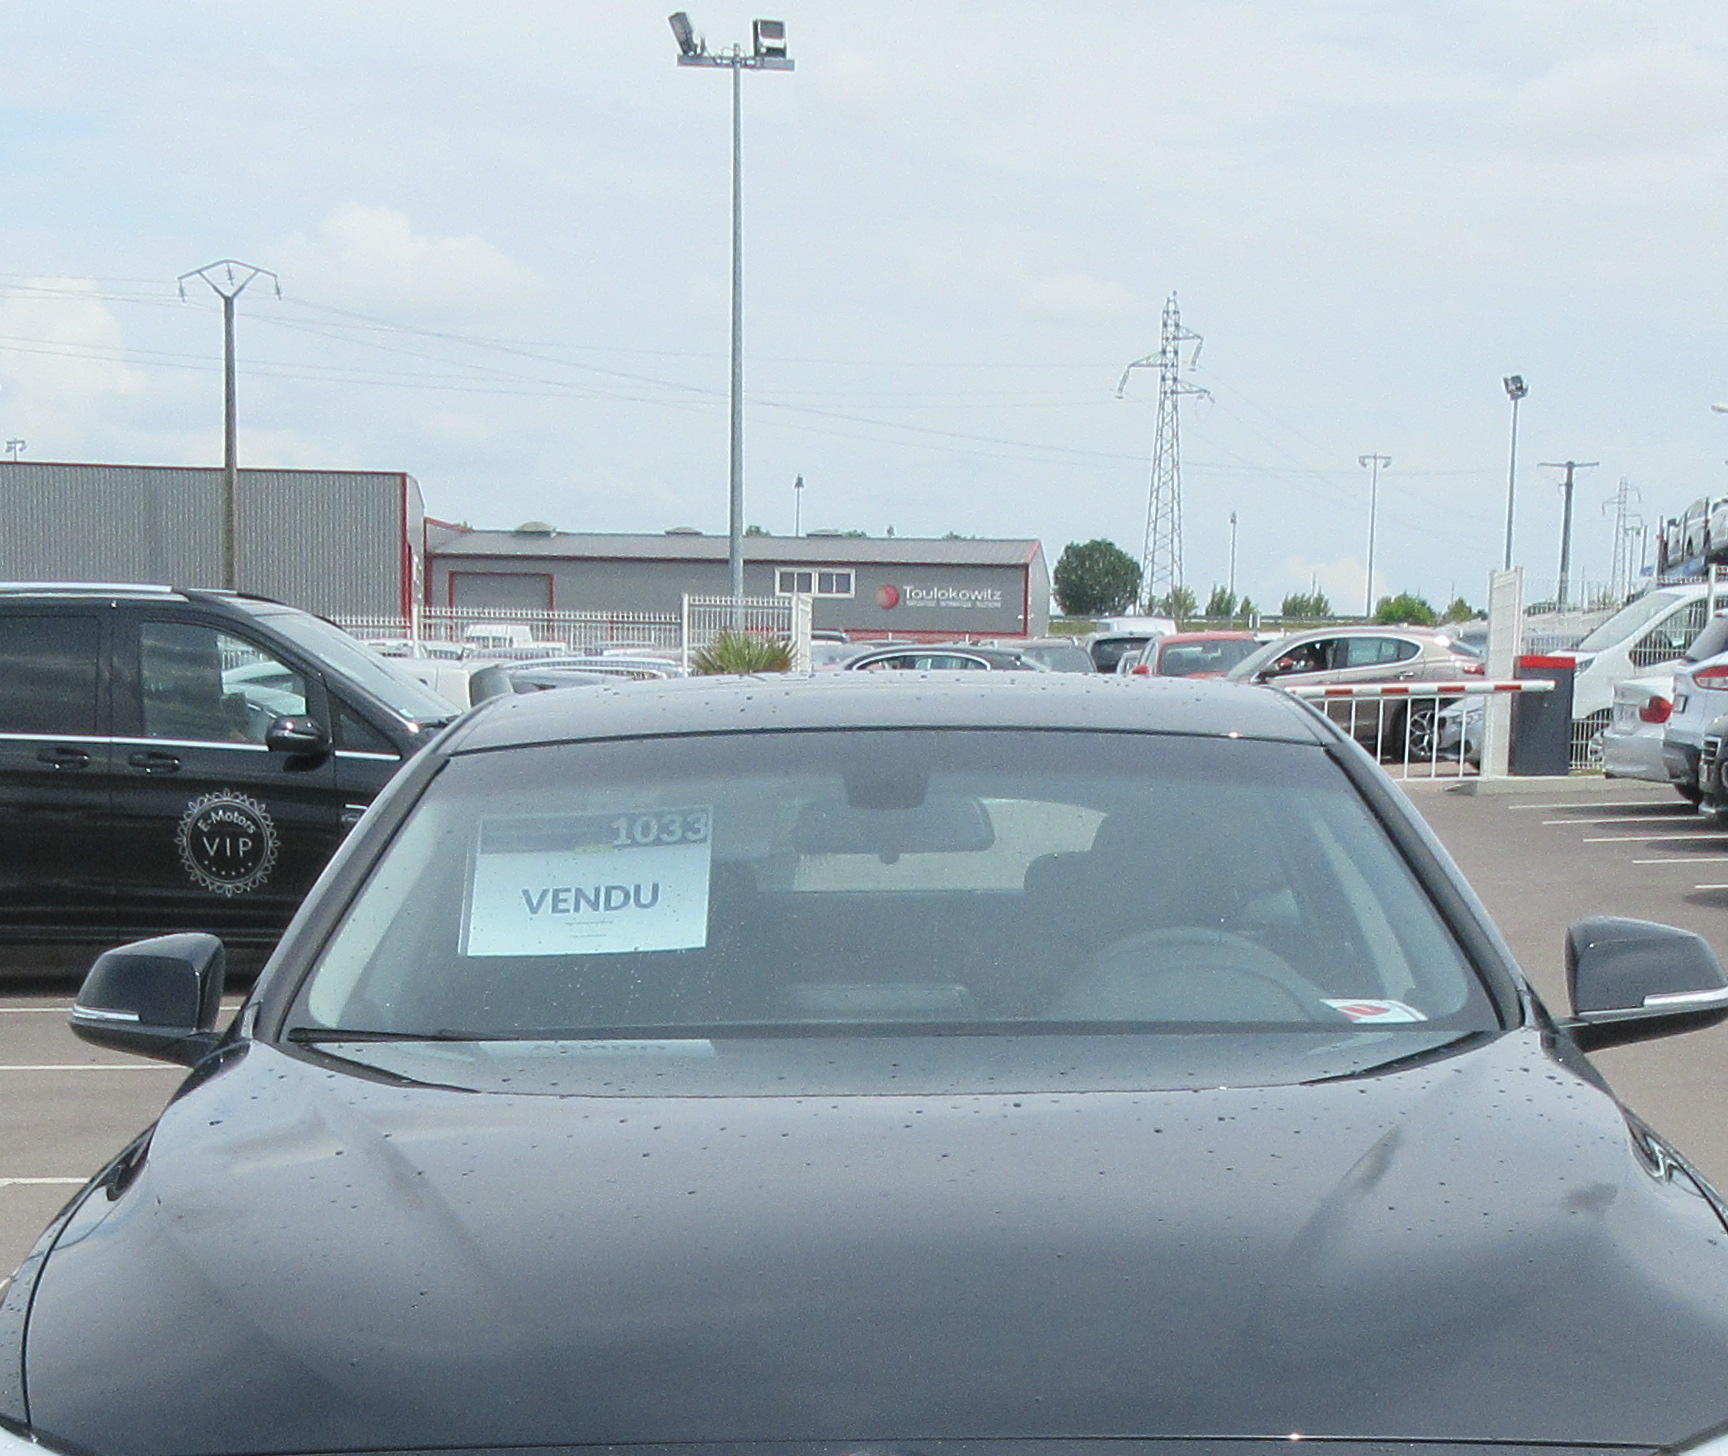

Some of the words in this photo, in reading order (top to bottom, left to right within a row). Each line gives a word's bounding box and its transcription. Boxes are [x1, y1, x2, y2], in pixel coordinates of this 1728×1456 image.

[903, 585, 1002, 601] Toulokowitz
[197, 810, 256, 834] E-Motors
[612, 812, 707, 846] 1033
[203, 837, 252, 857] VIP
[522, 882, 660, 915] VENDU
